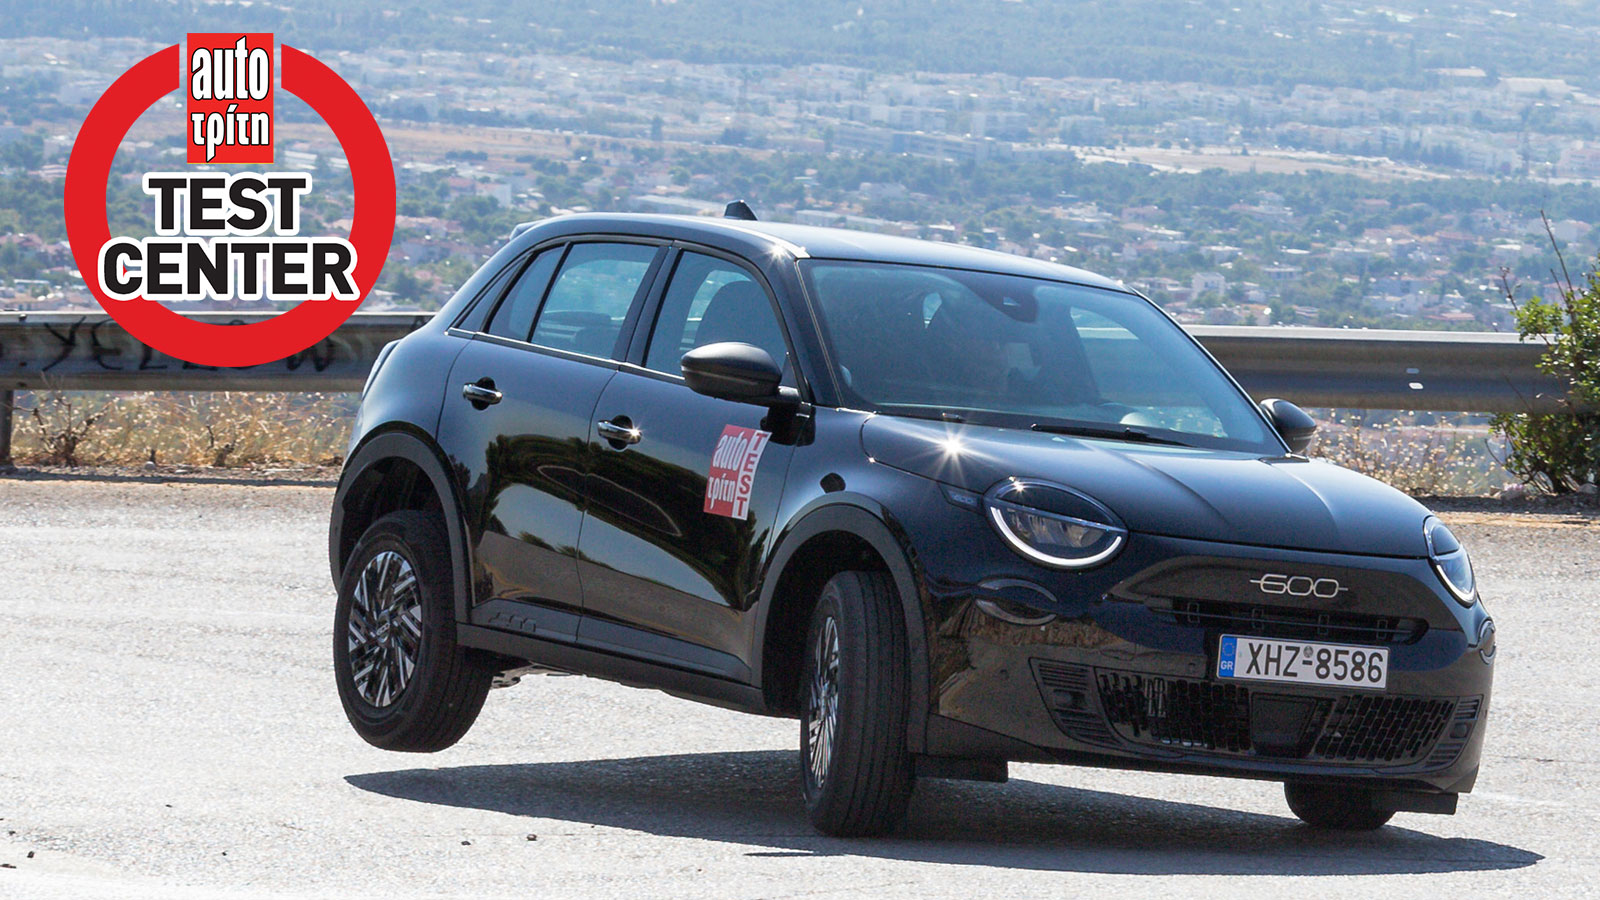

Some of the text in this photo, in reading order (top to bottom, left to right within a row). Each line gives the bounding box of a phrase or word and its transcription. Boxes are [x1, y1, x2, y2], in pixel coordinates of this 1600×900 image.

[712, 430, 748, 472] auto
[736, 432, 768, 517] TEST
[1249, 573, 1349, 598] 600
[1220, 660, 1234, 671] GR
